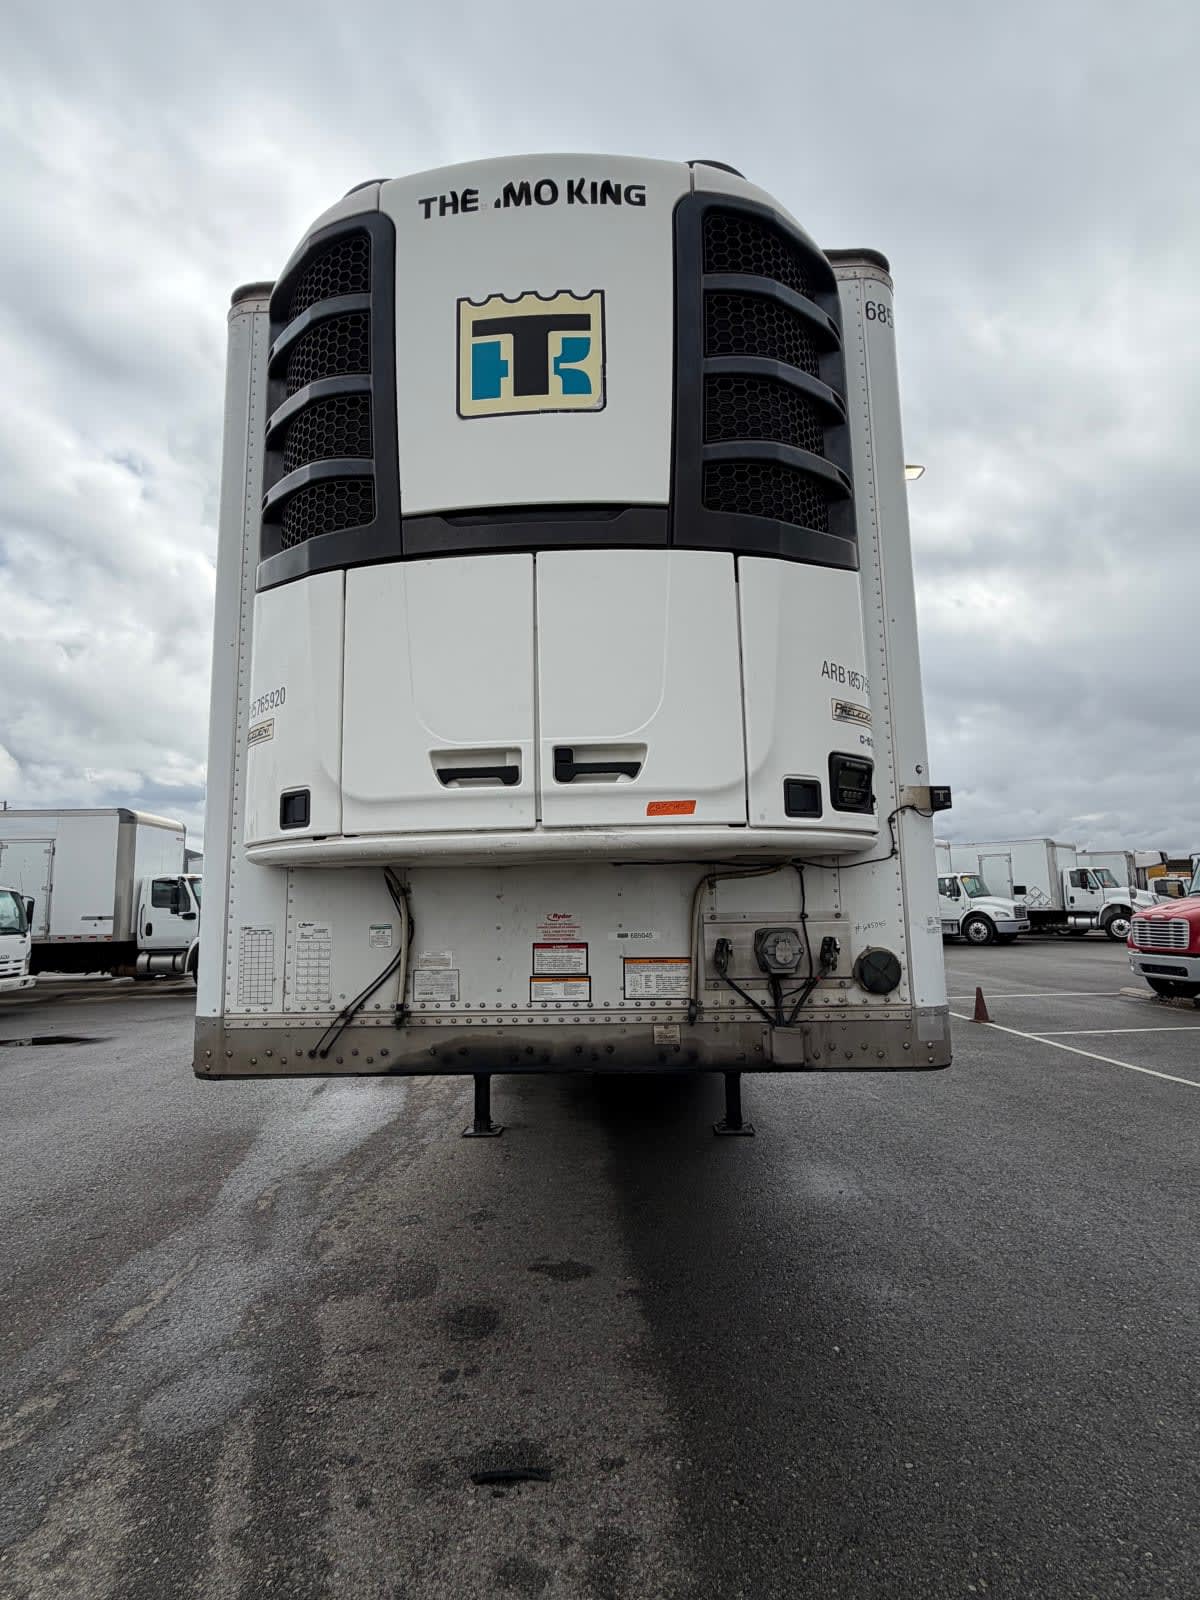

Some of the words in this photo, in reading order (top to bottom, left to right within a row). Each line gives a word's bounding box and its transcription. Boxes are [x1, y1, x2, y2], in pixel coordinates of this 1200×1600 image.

[418, 178, 559, 220] THEMO
[566, 177, 647, 207] KING
[821, 660, 846, 684] ARB
